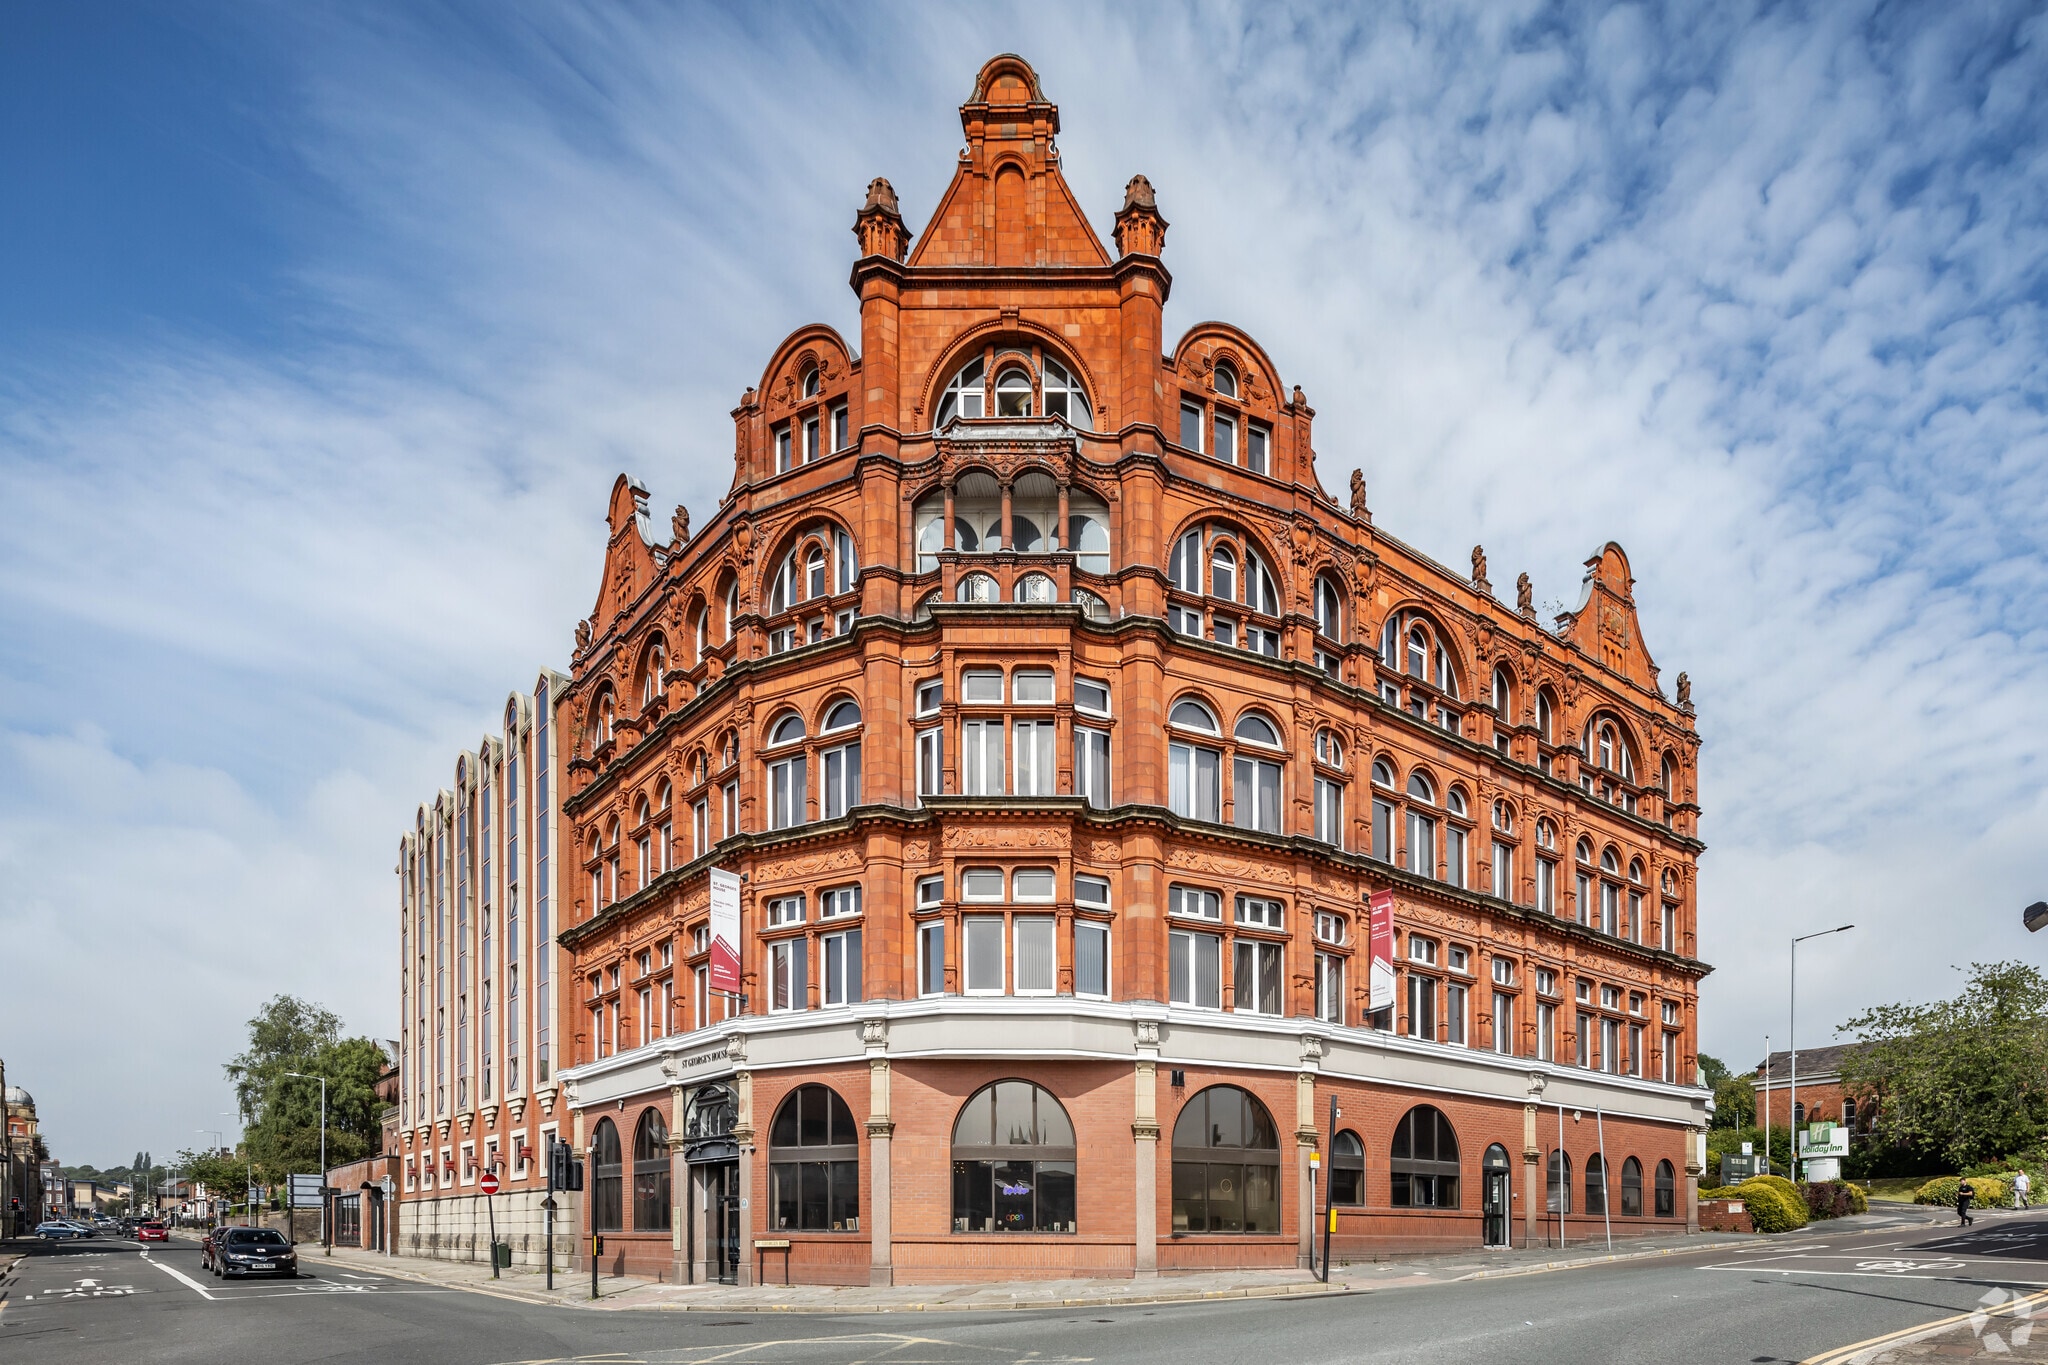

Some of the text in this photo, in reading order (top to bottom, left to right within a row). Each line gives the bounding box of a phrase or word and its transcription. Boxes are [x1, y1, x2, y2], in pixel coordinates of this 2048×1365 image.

[682, 1059, 687, 1068] ST
[688, 1053, 711, 1067] GEORGE'S
[1801, 1143, 1843, 1154] Holiday Inn
[1006, 1213, 1025, 1222] open
[25, 1288, 154, 1300] LANE
